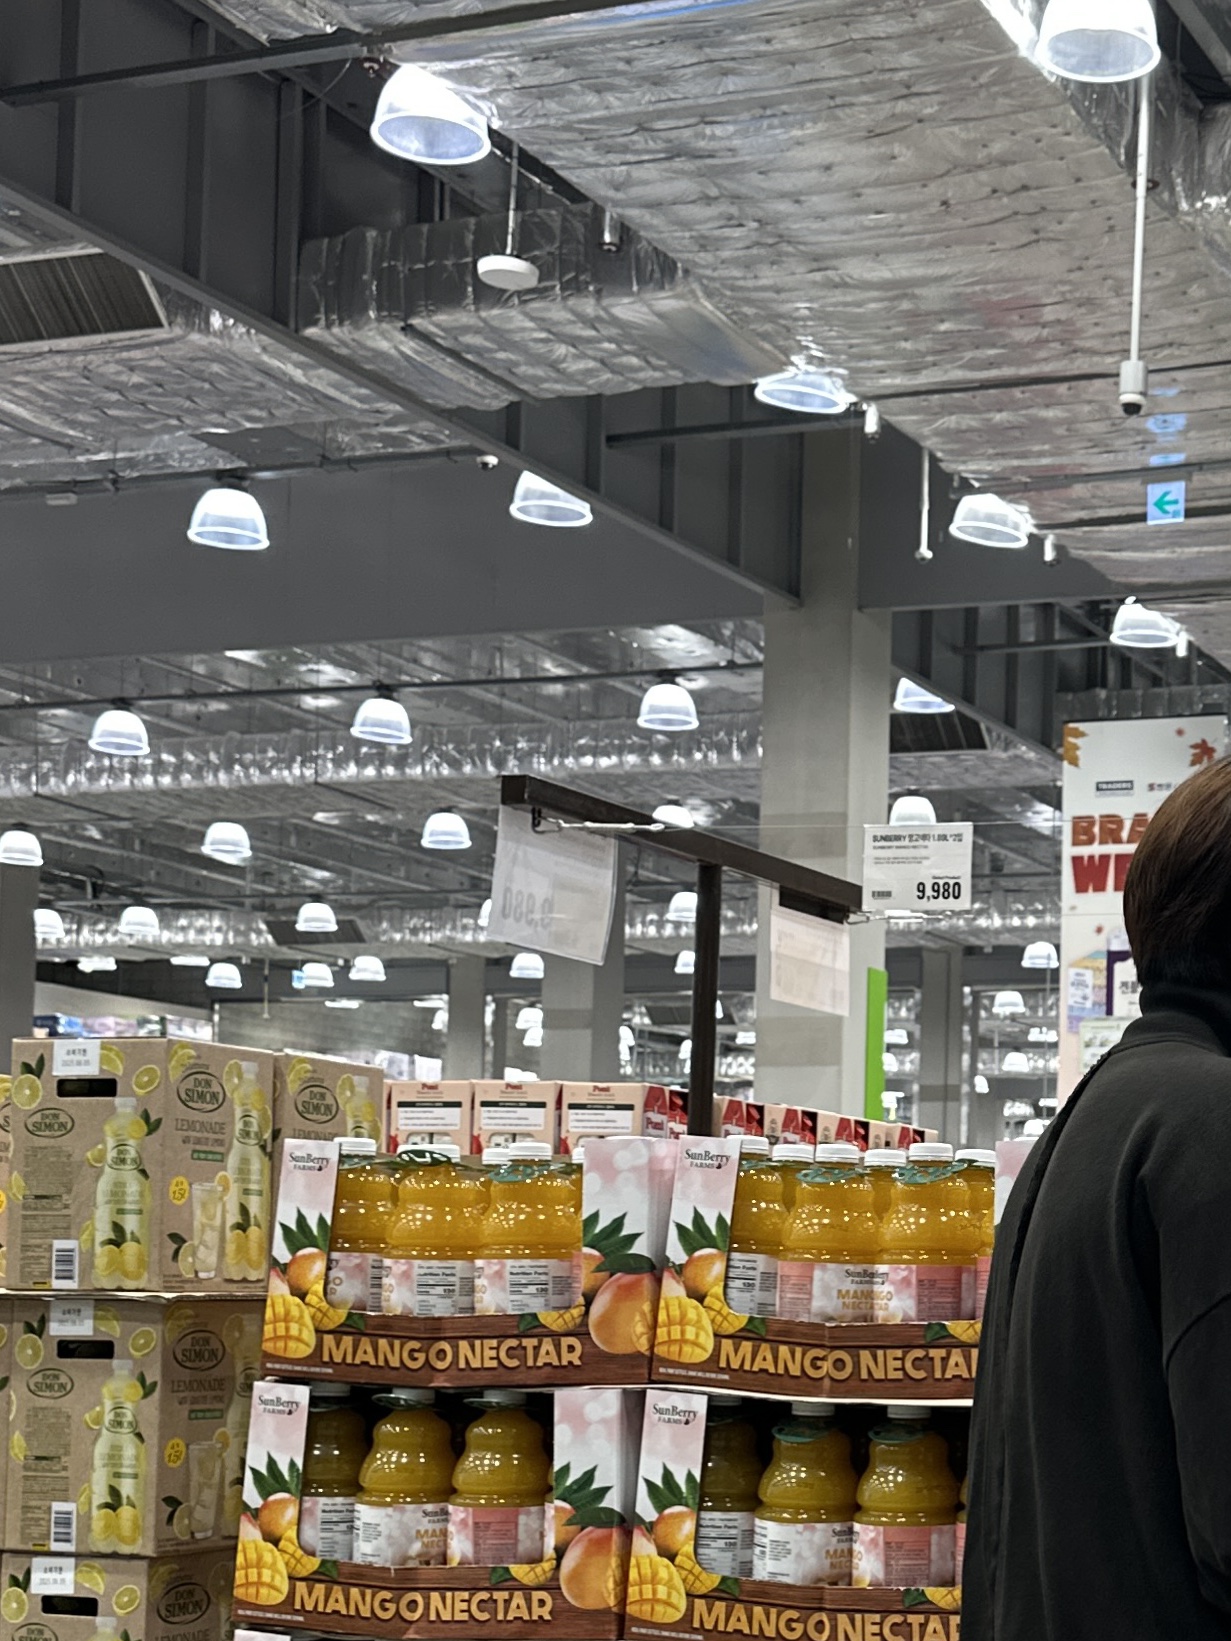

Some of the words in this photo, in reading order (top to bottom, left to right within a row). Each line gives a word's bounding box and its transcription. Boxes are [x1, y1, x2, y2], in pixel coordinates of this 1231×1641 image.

[916, 882, 961, 902] 9,980
[288, 1153, 330, 1166] SunBerry
[684, 1149, 731, 1164] SunBerry
[322, 1335, 452, 1369] MANGO
[459, 1338, 582, 1369] NECTAR
[719, 1339, 853, 1379] MANGO
[258, 1395, 300, 1412] SunBerry
[652, 1404, 698, 1421] SunBerry
[294, 1581, 424, 1621] MANGO
[429, 1590, 553, 1621] NECTAR
